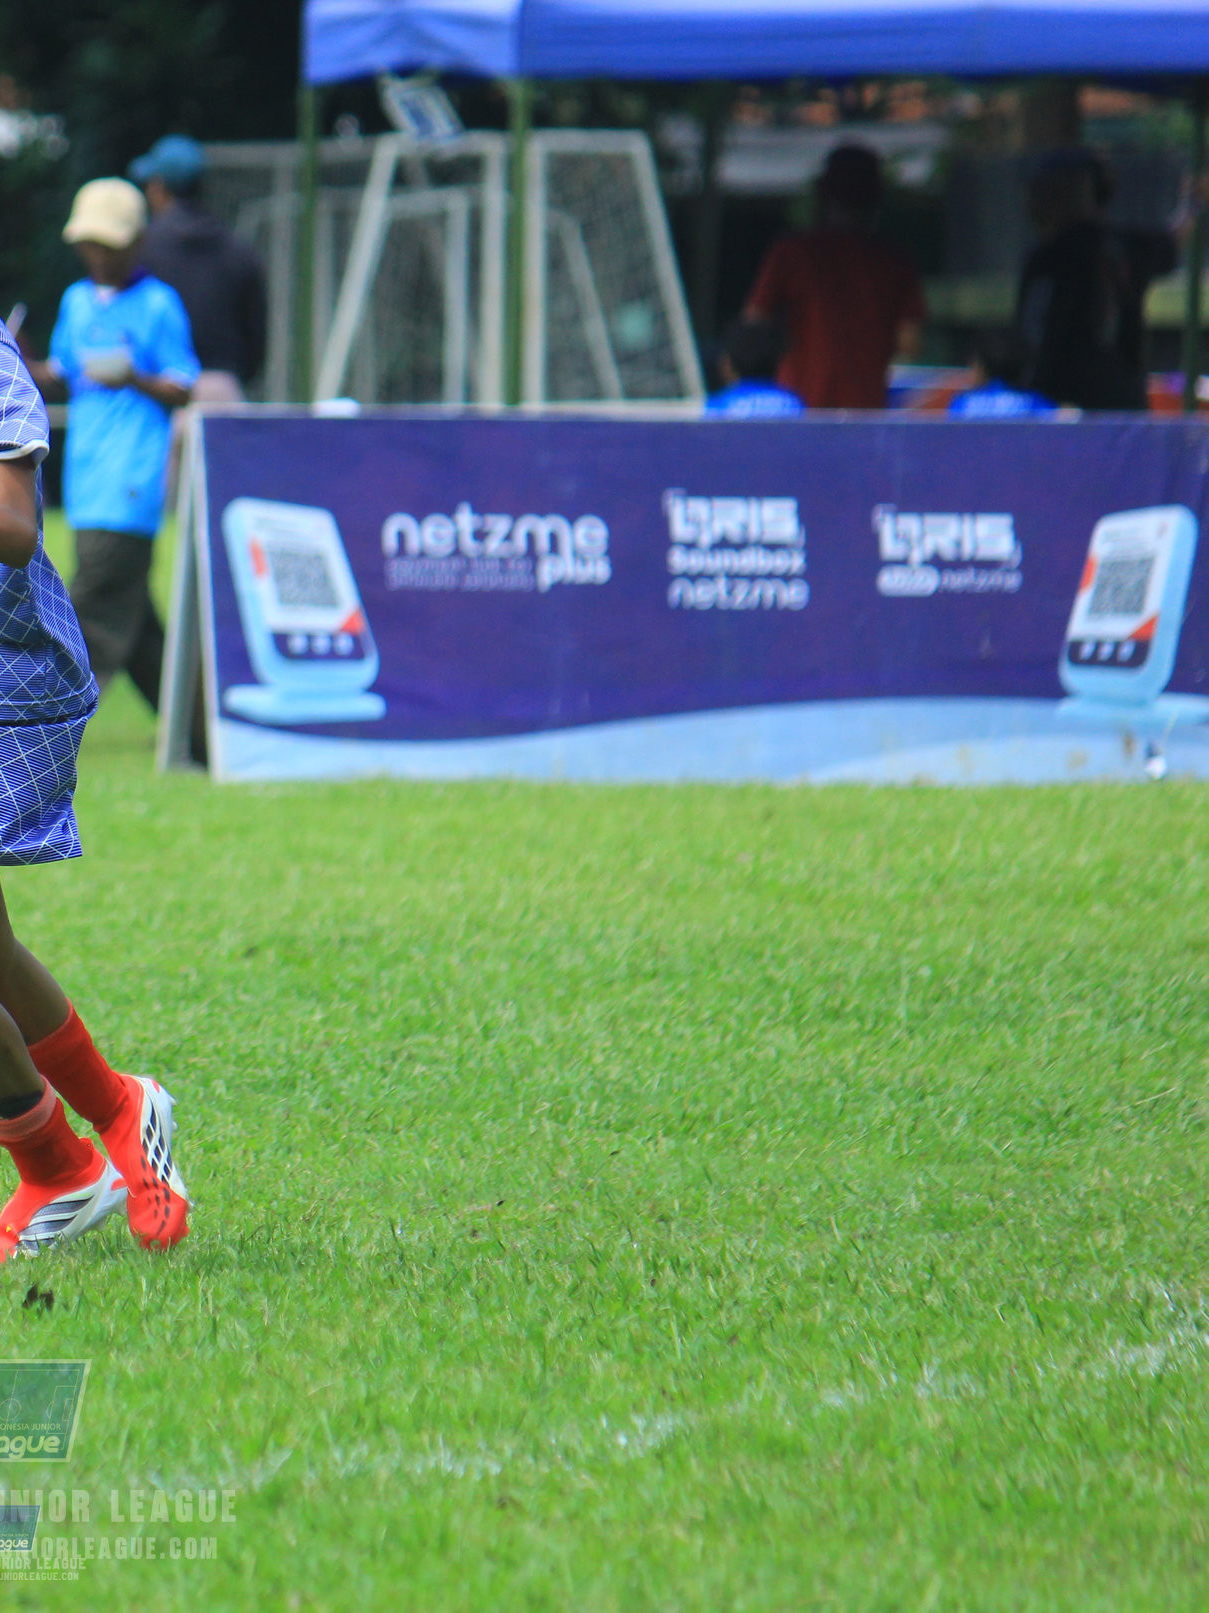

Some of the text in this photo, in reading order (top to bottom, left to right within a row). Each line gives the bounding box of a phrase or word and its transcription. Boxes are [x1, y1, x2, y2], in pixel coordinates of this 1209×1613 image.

[381, 501, 609, 560] netzme
[537, 554, 612, 593] plus
[667, 573, 810, 610] netzme
